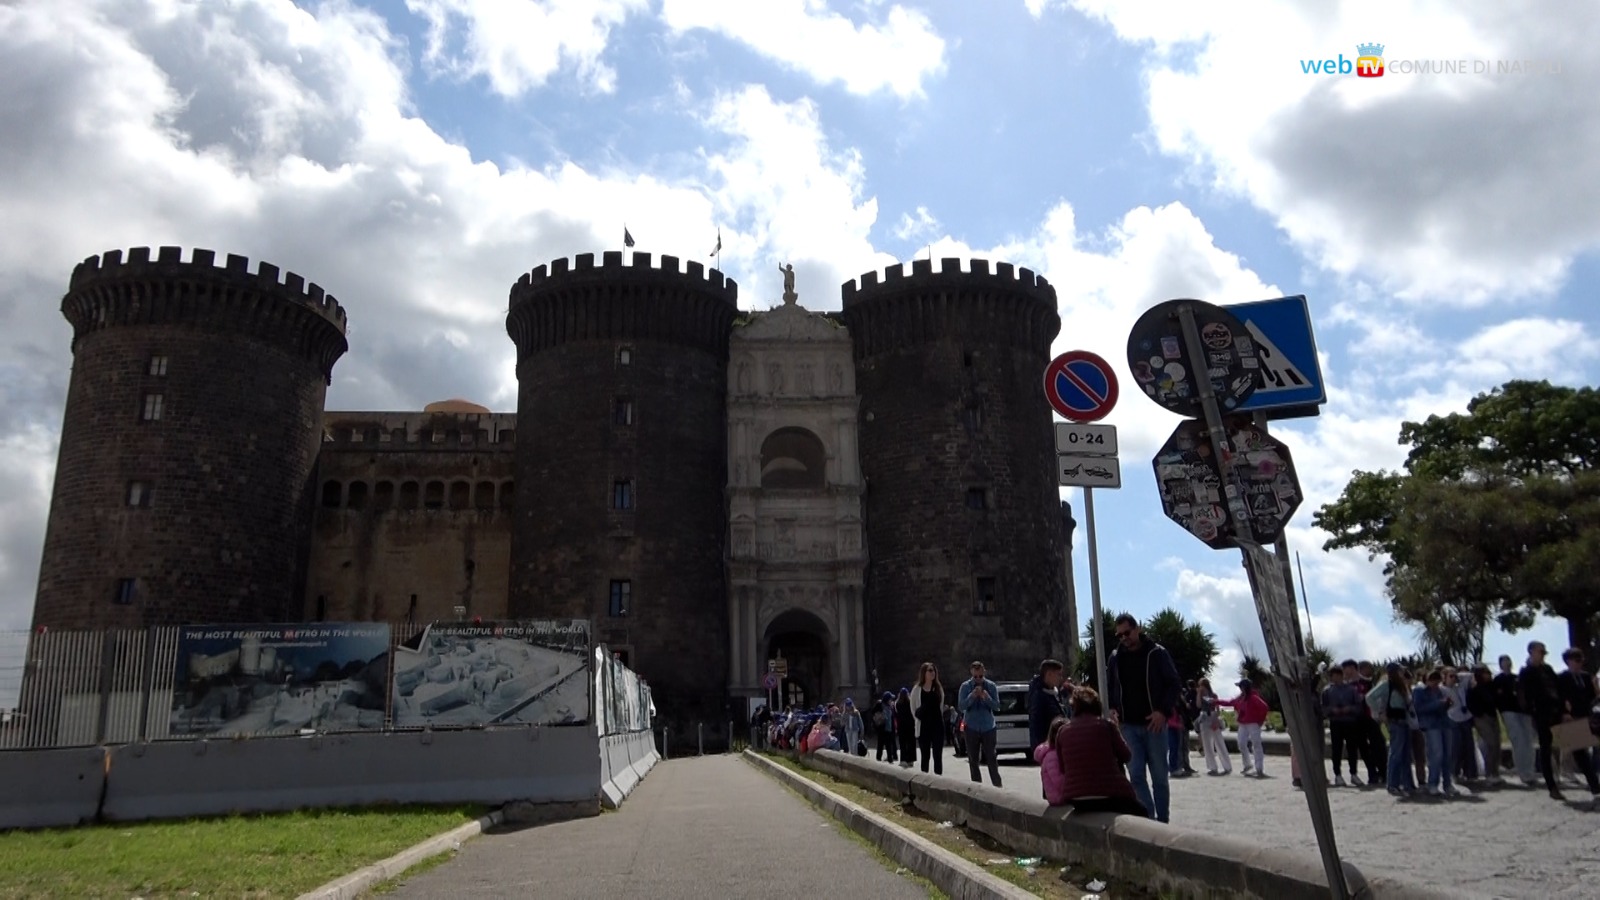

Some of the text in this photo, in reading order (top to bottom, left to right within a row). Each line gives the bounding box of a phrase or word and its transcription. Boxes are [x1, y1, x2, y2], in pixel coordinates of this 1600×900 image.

[1068, 432, 1104, 445] 0-24
[185, 629, 383, 639] THE MOST BEAUTIFUL METRO IN THE WORLD
[447, 627, 492, 635] BEAUTIFUL
[494, 627, 524, 635] METRO
[525, 627, 535, 635] IN
[555, 626, 584, 634] WORLD
